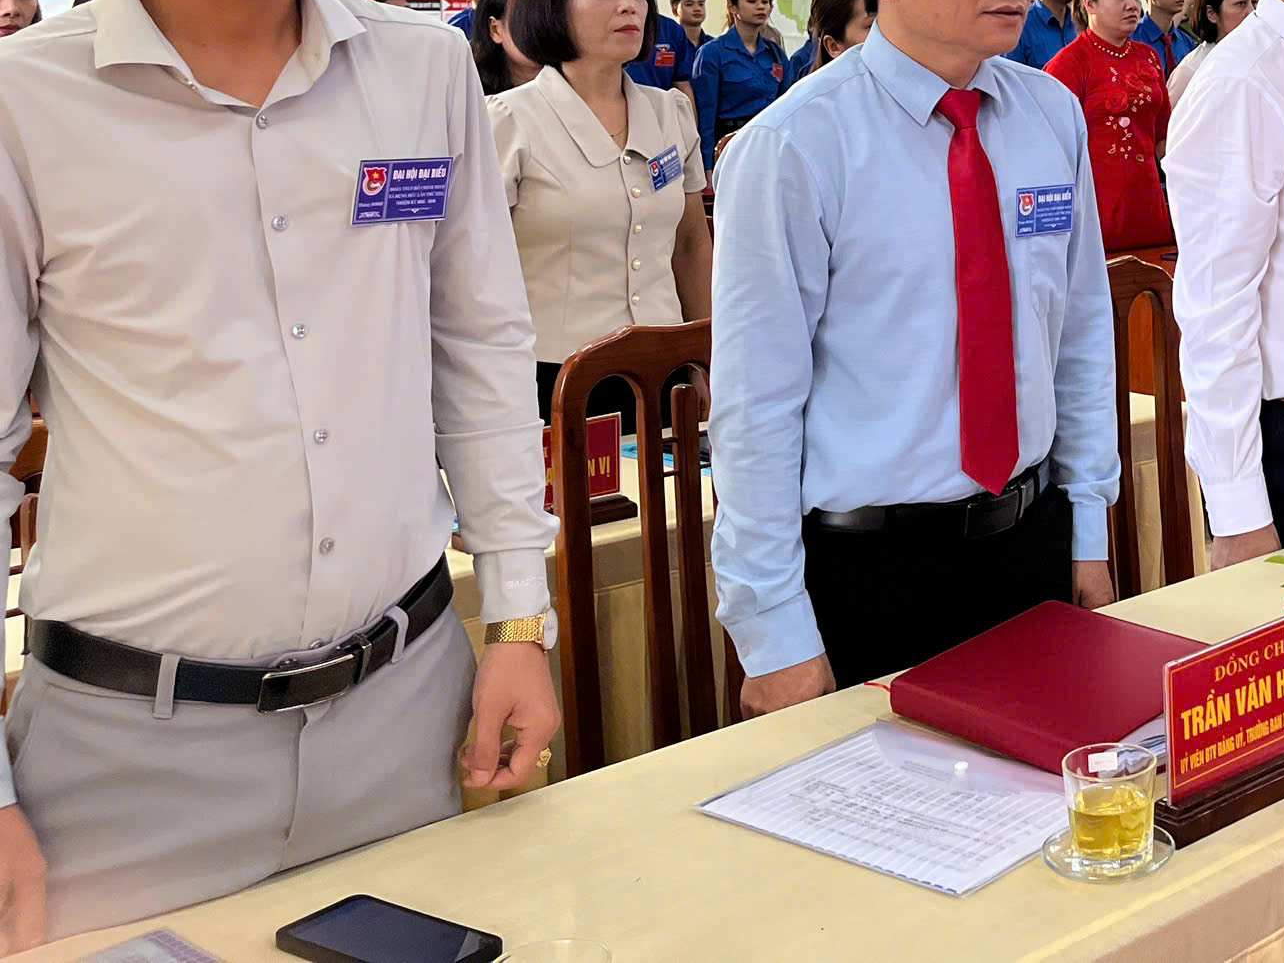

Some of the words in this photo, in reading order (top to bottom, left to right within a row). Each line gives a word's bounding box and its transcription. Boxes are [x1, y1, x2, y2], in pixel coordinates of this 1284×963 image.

[1214, 652, 1260, 683] ĐỒNG
[1181, 688, 1231, 741] TRẦN
[1235, 675, 1271, 717] VĂN
